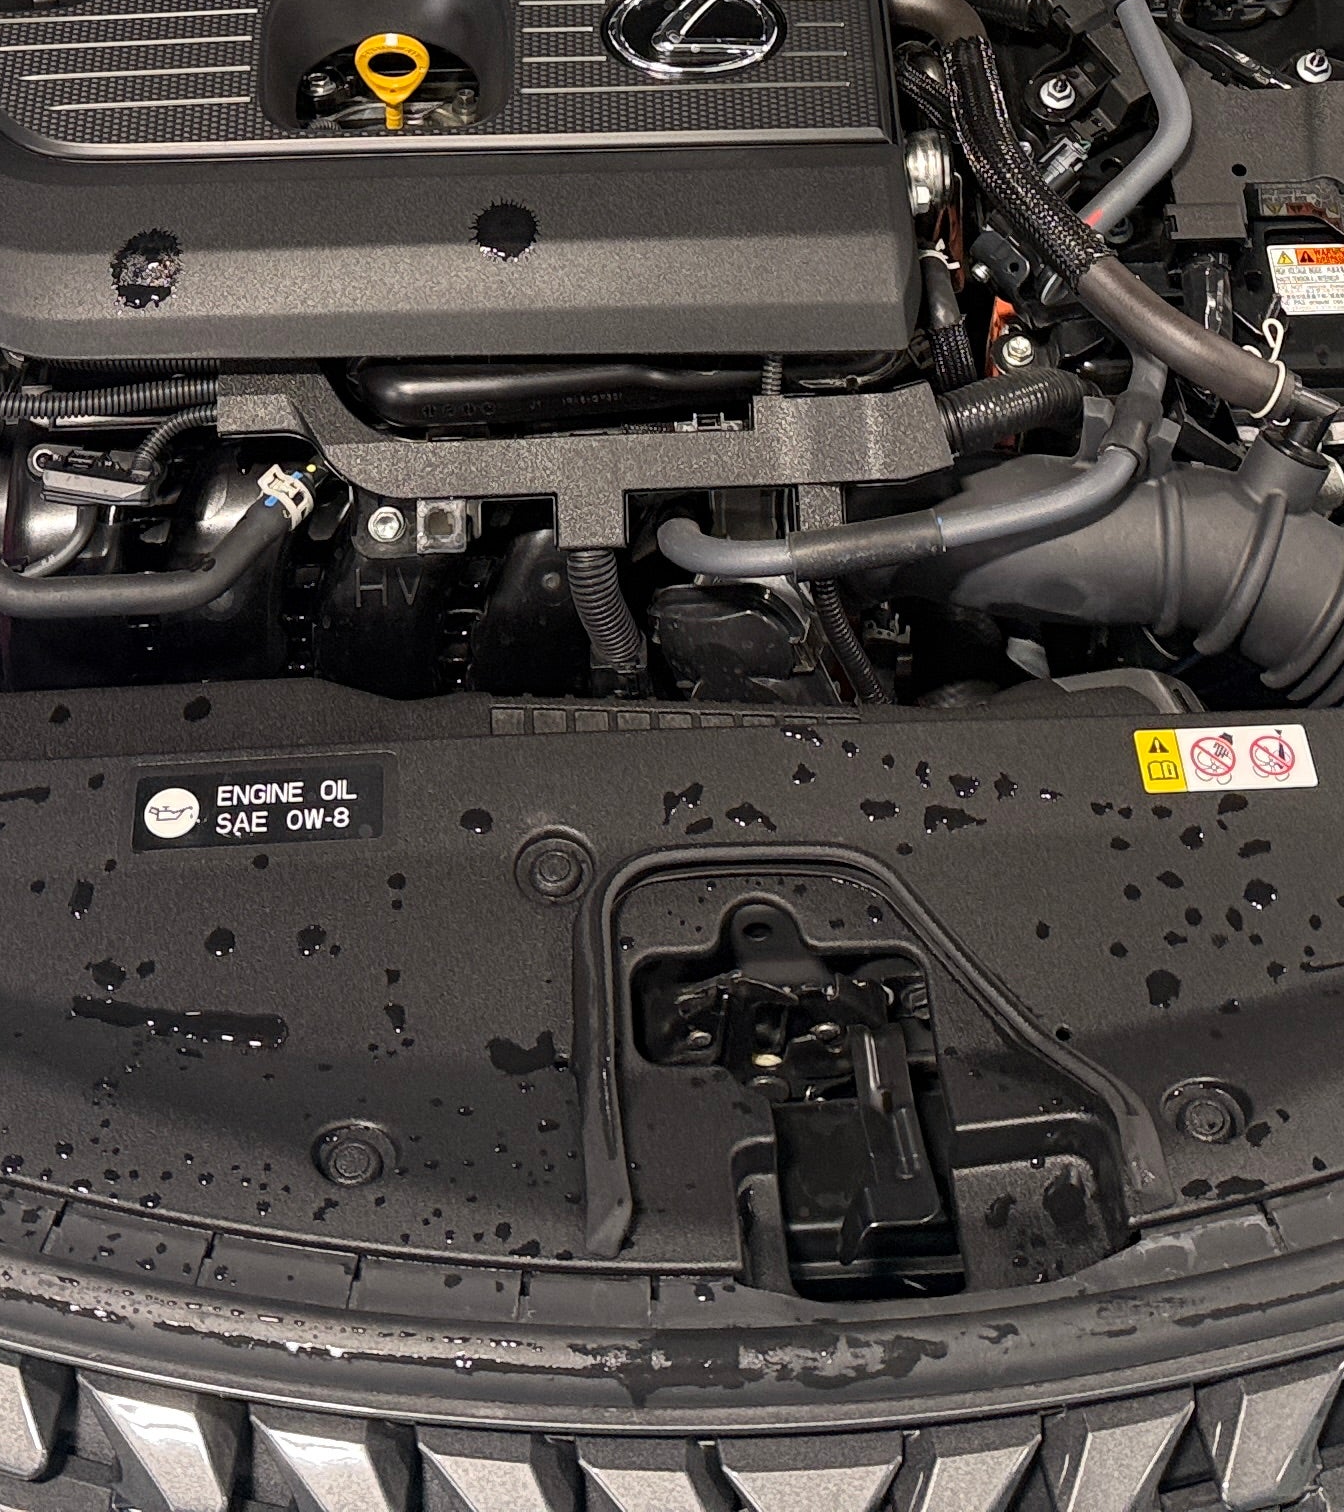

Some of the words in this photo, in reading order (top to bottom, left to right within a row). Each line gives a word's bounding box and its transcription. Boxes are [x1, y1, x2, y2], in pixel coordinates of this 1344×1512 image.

[356, 567, 423, 608] HV
[216, 781, 304, 807] ENGINE
[320, 779, 357, 802] OIL
[215, 811, 269, 834] SAE
